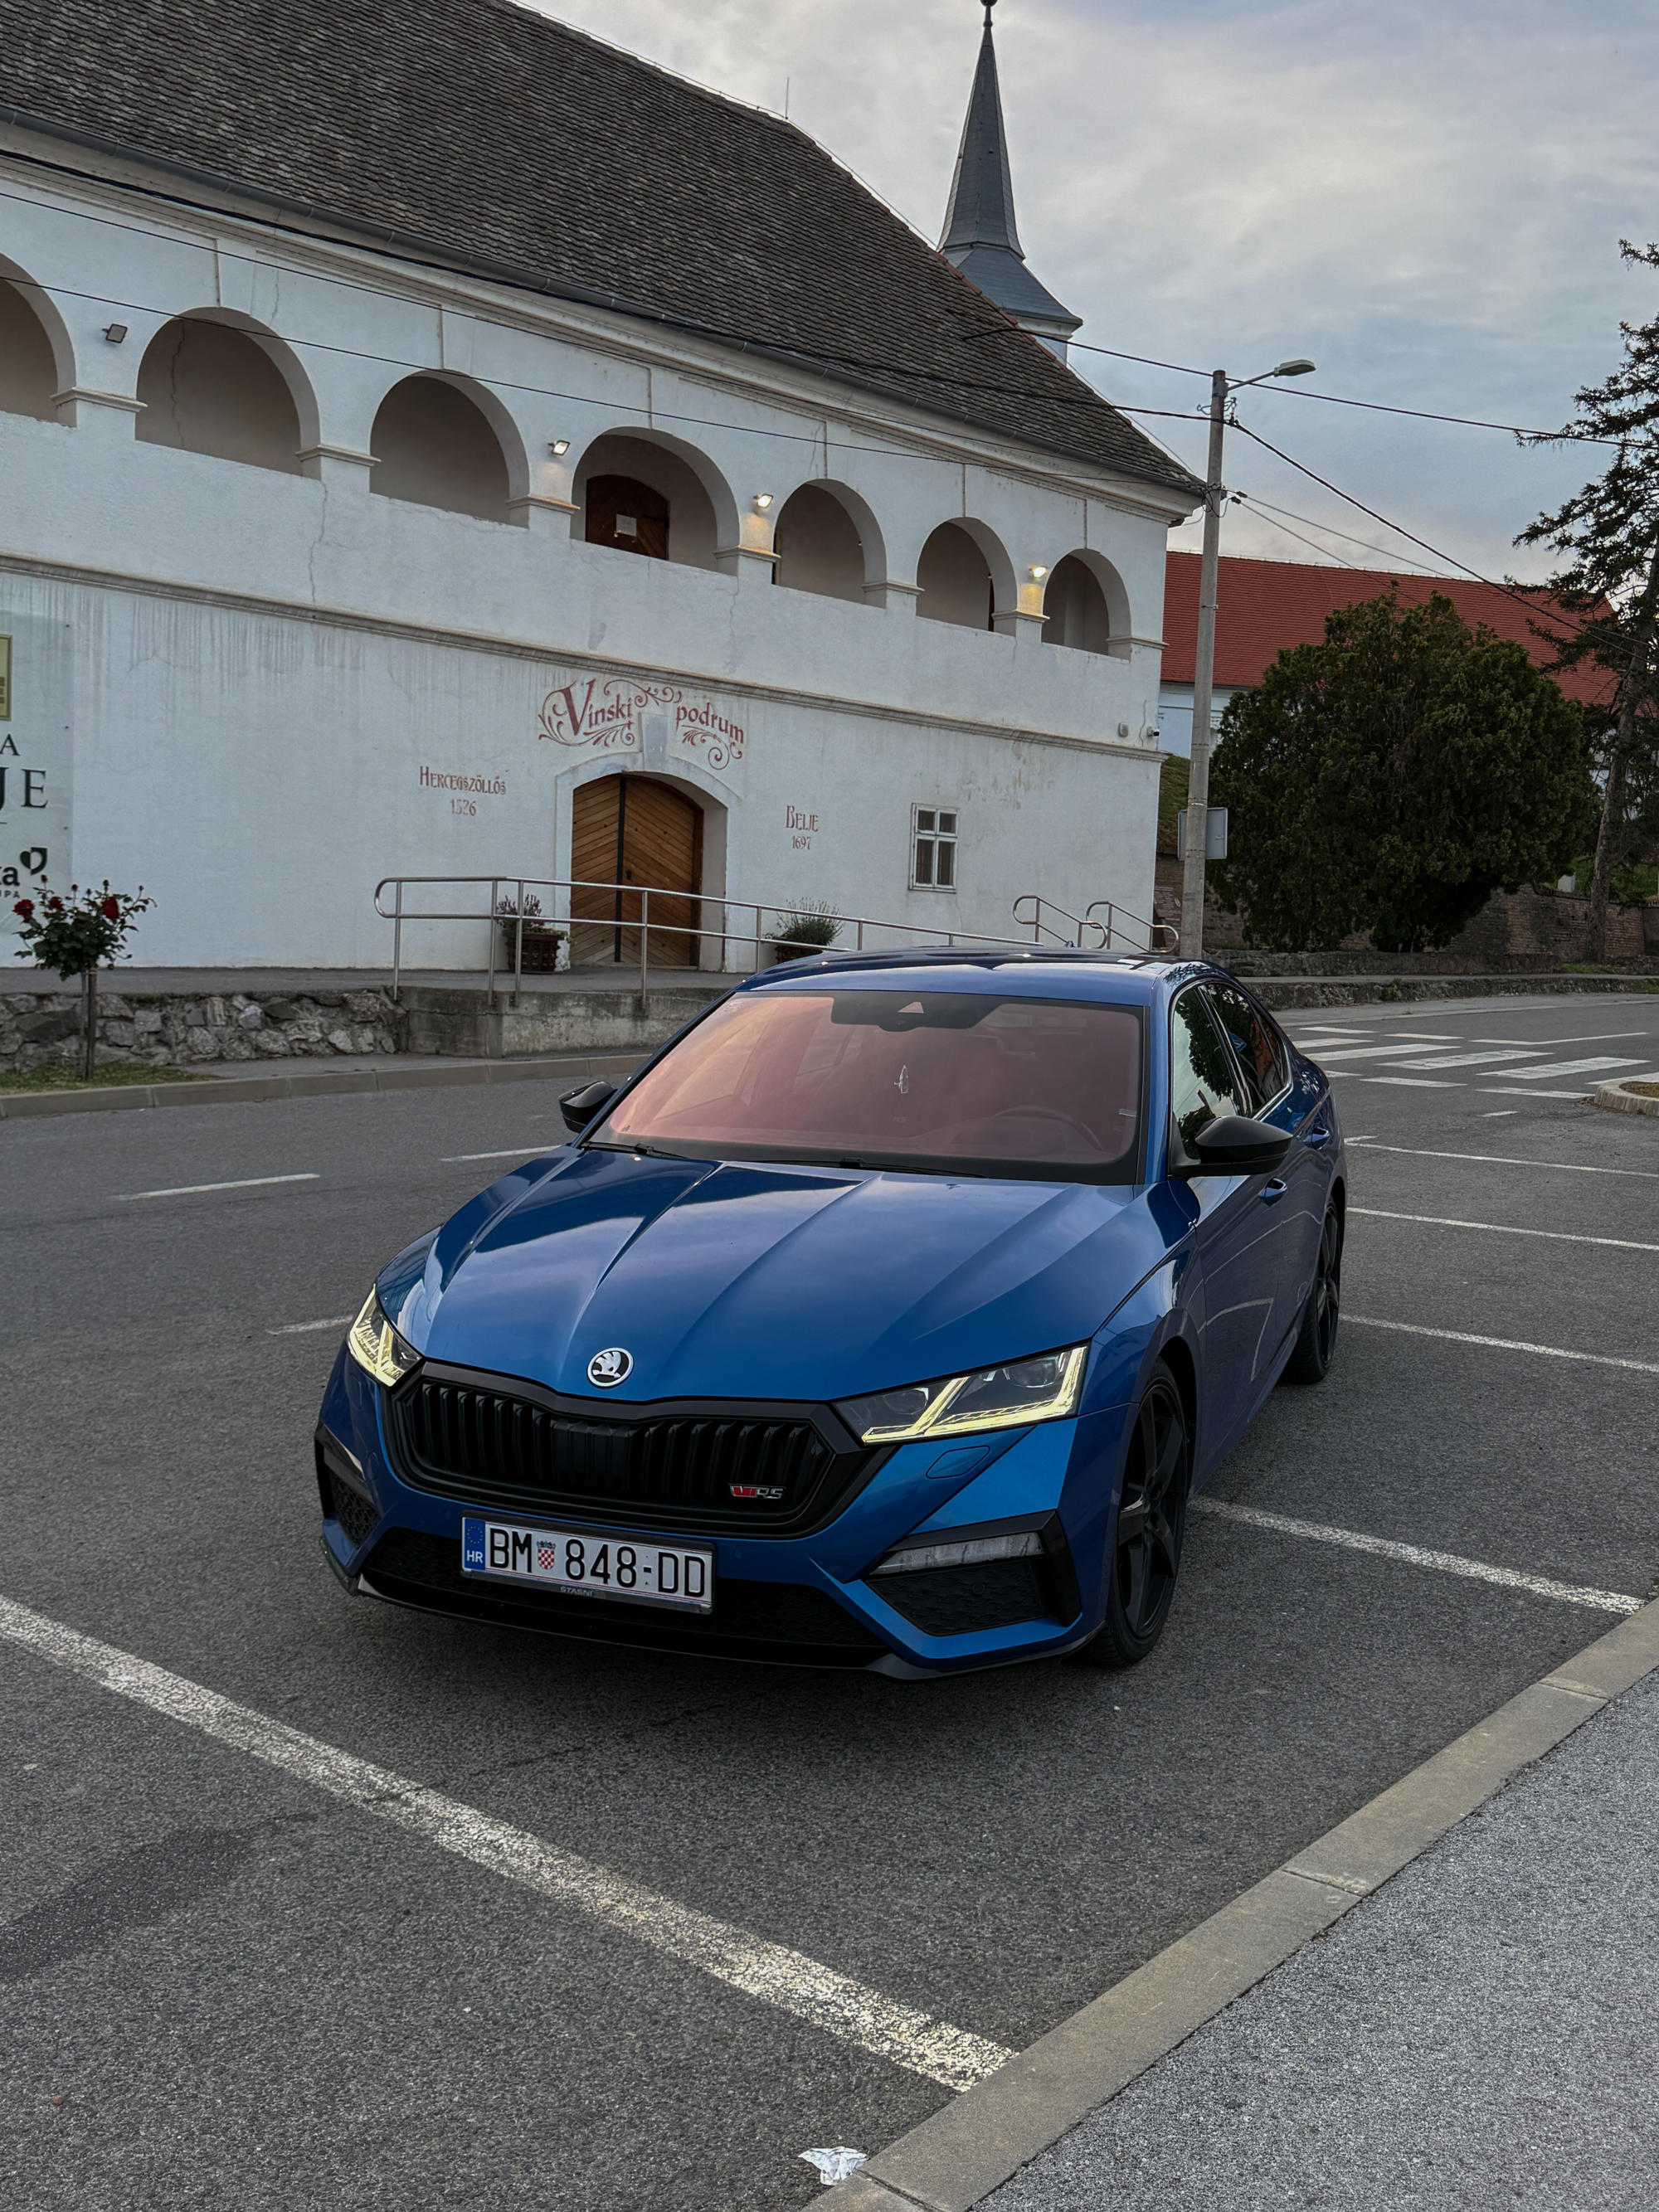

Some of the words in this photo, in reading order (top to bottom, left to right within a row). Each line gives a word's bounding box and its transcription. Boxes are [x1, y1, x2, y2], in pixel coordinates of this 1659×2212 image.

[561, 678, 634, 737] Vinski
[675, 702, 745, 745] podrum
[450, 798, 477, 817] 1526
[792, 835, 811, 850] 1697
[0, 866, 20, 887] a
[466, 1549, 484, 1565] HR
[489, 1527, 533, 1574] BM
[565, 1539, 706, 1598] 848-DD
